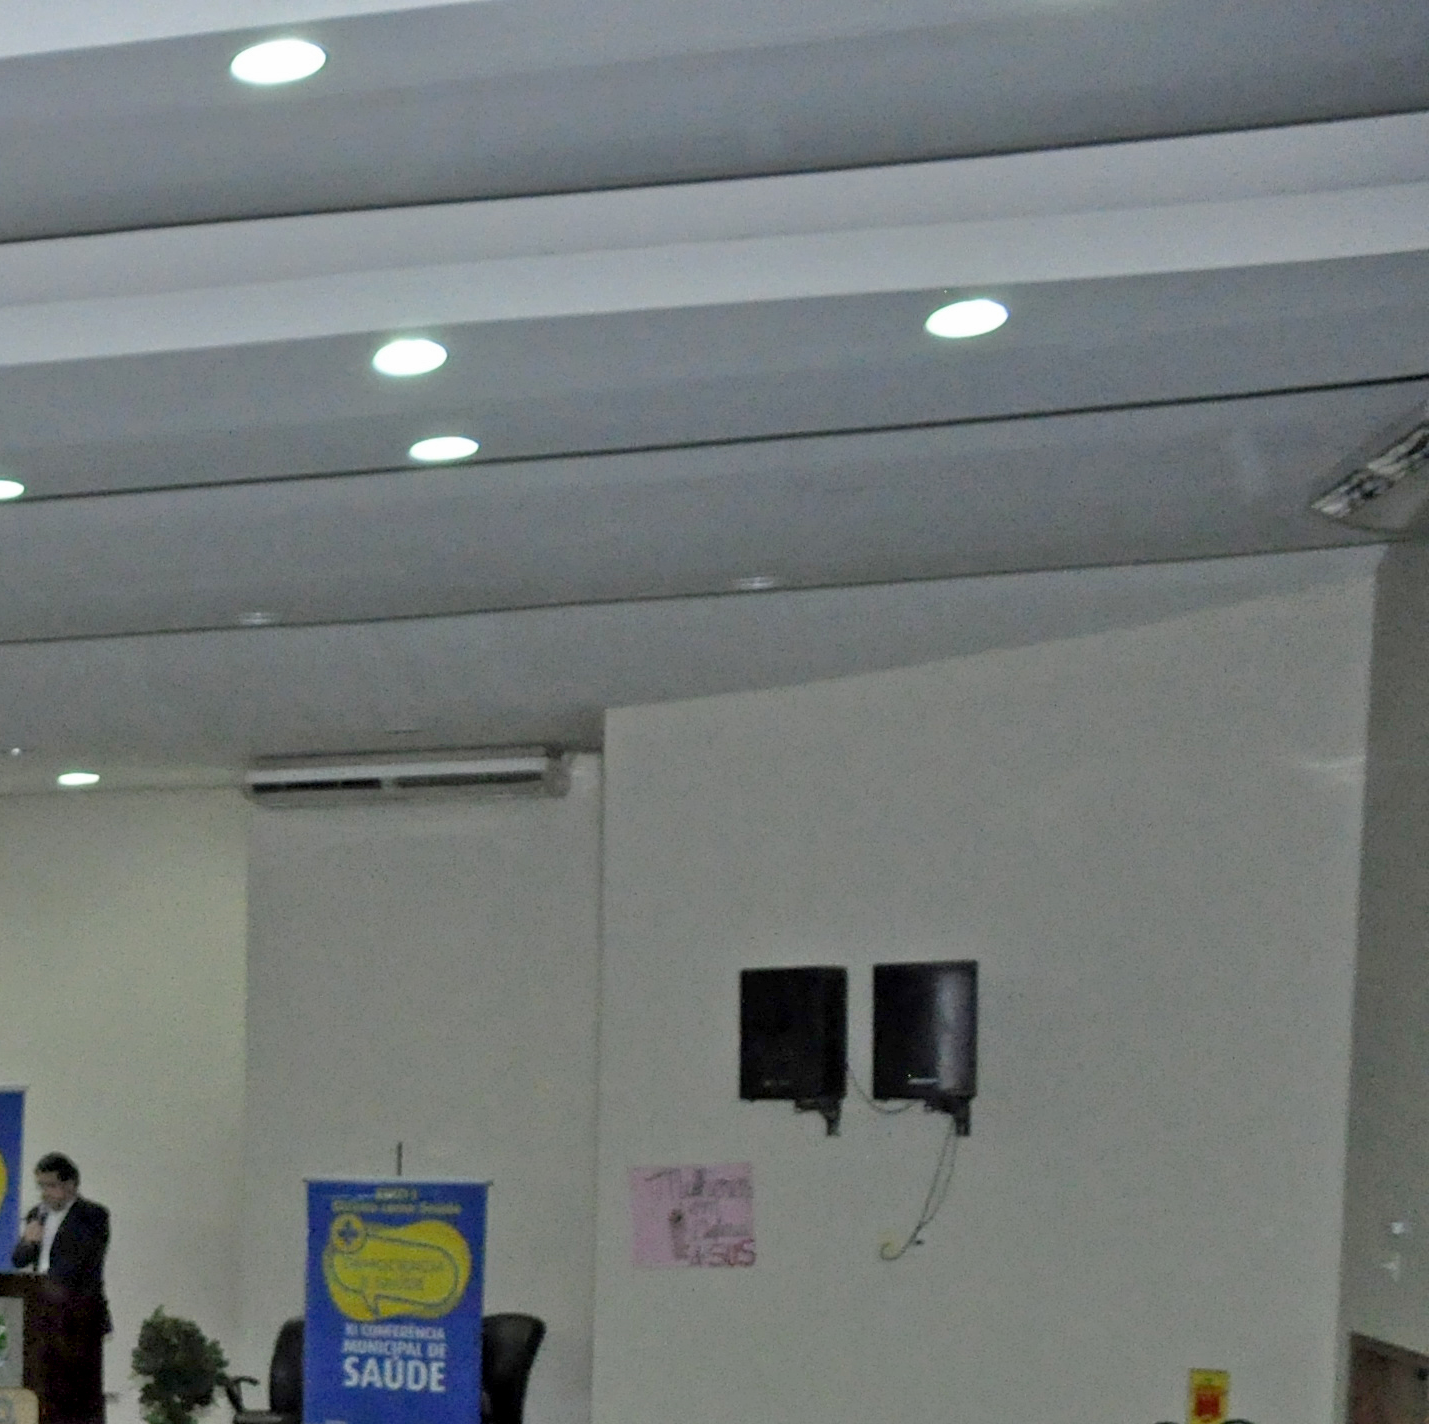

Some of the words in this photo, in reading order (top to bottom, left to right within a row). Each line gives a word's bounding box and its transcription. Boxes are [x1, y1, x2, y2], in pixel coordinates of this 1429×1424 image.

[342, 1339, 423, 1358] MUNICIPAL
[427, 1342, 446, 1358] DE
[343, 1356, 446, 1393] SAÚDE
